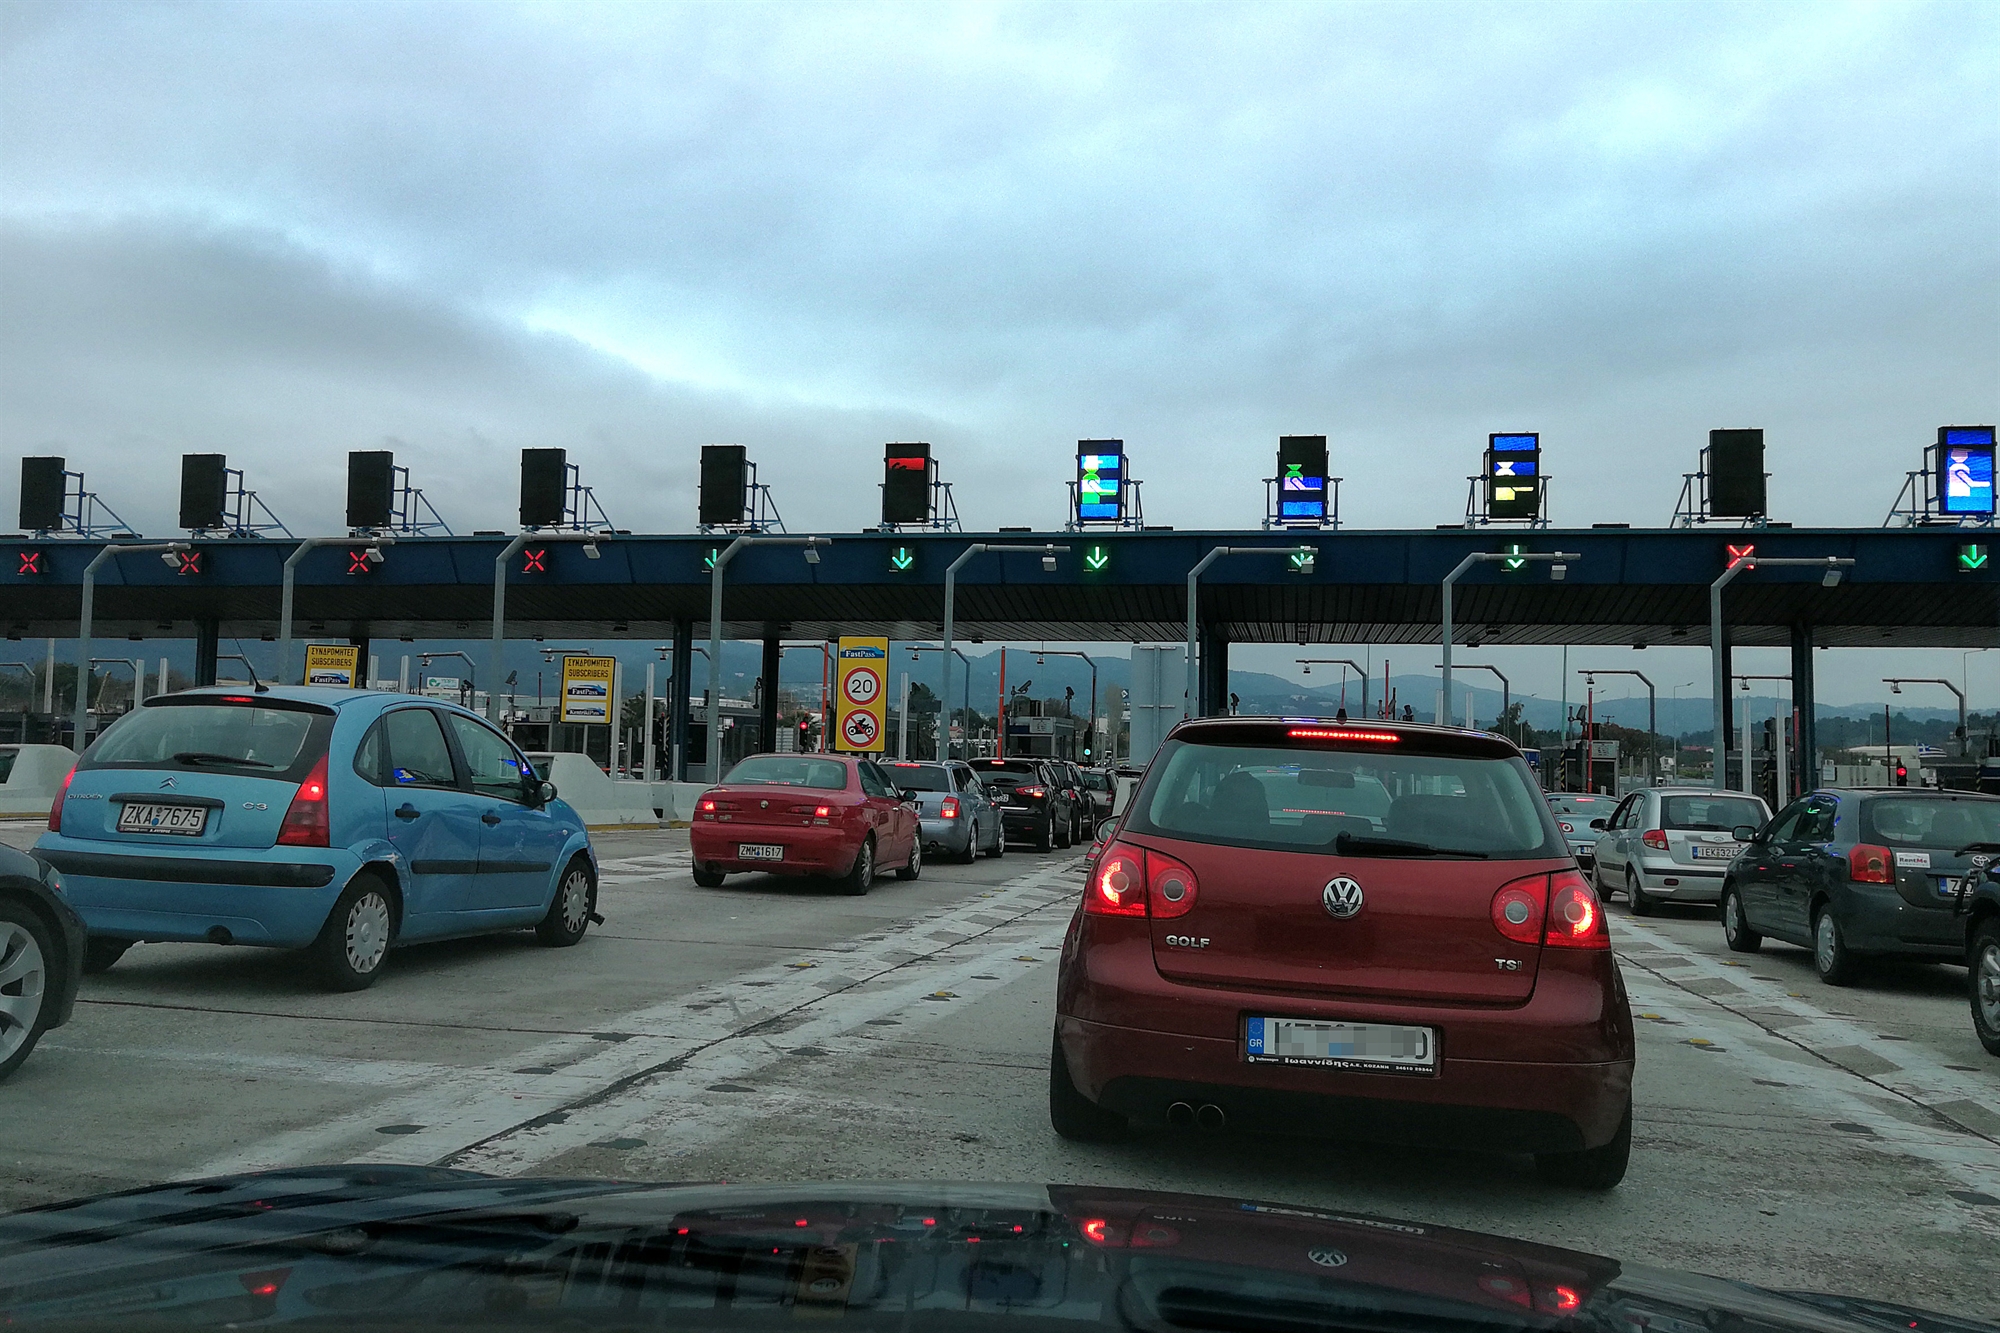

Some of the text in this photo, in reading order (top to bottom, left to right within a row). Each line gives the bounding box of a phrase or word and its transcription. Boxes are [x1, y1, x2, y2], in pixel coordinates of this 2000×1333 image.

[311, 647, 354, 657] ΣΥΝΔΡΟΜΗΤΕΣ
[846, 650, 876, 658] FastPass
[311, 657, 353, 667] SUBSCRIBERS
[568, 658, 611, 668] ΣΥΝΔΡΟΜΗΤΕΣ
[568, 668, 609, 678] SUBSCRIBERS
[852, 679, 873, 694] 20
[242, 801, 268, 811] C3
[1165, 934, 1210, 948] GOLF
[1494, 958, 1523, 971] TSI
[1249, 1038, 1263, 1048] GR
[1284, 1057, 1349, 1068] Ιωαννίδης
